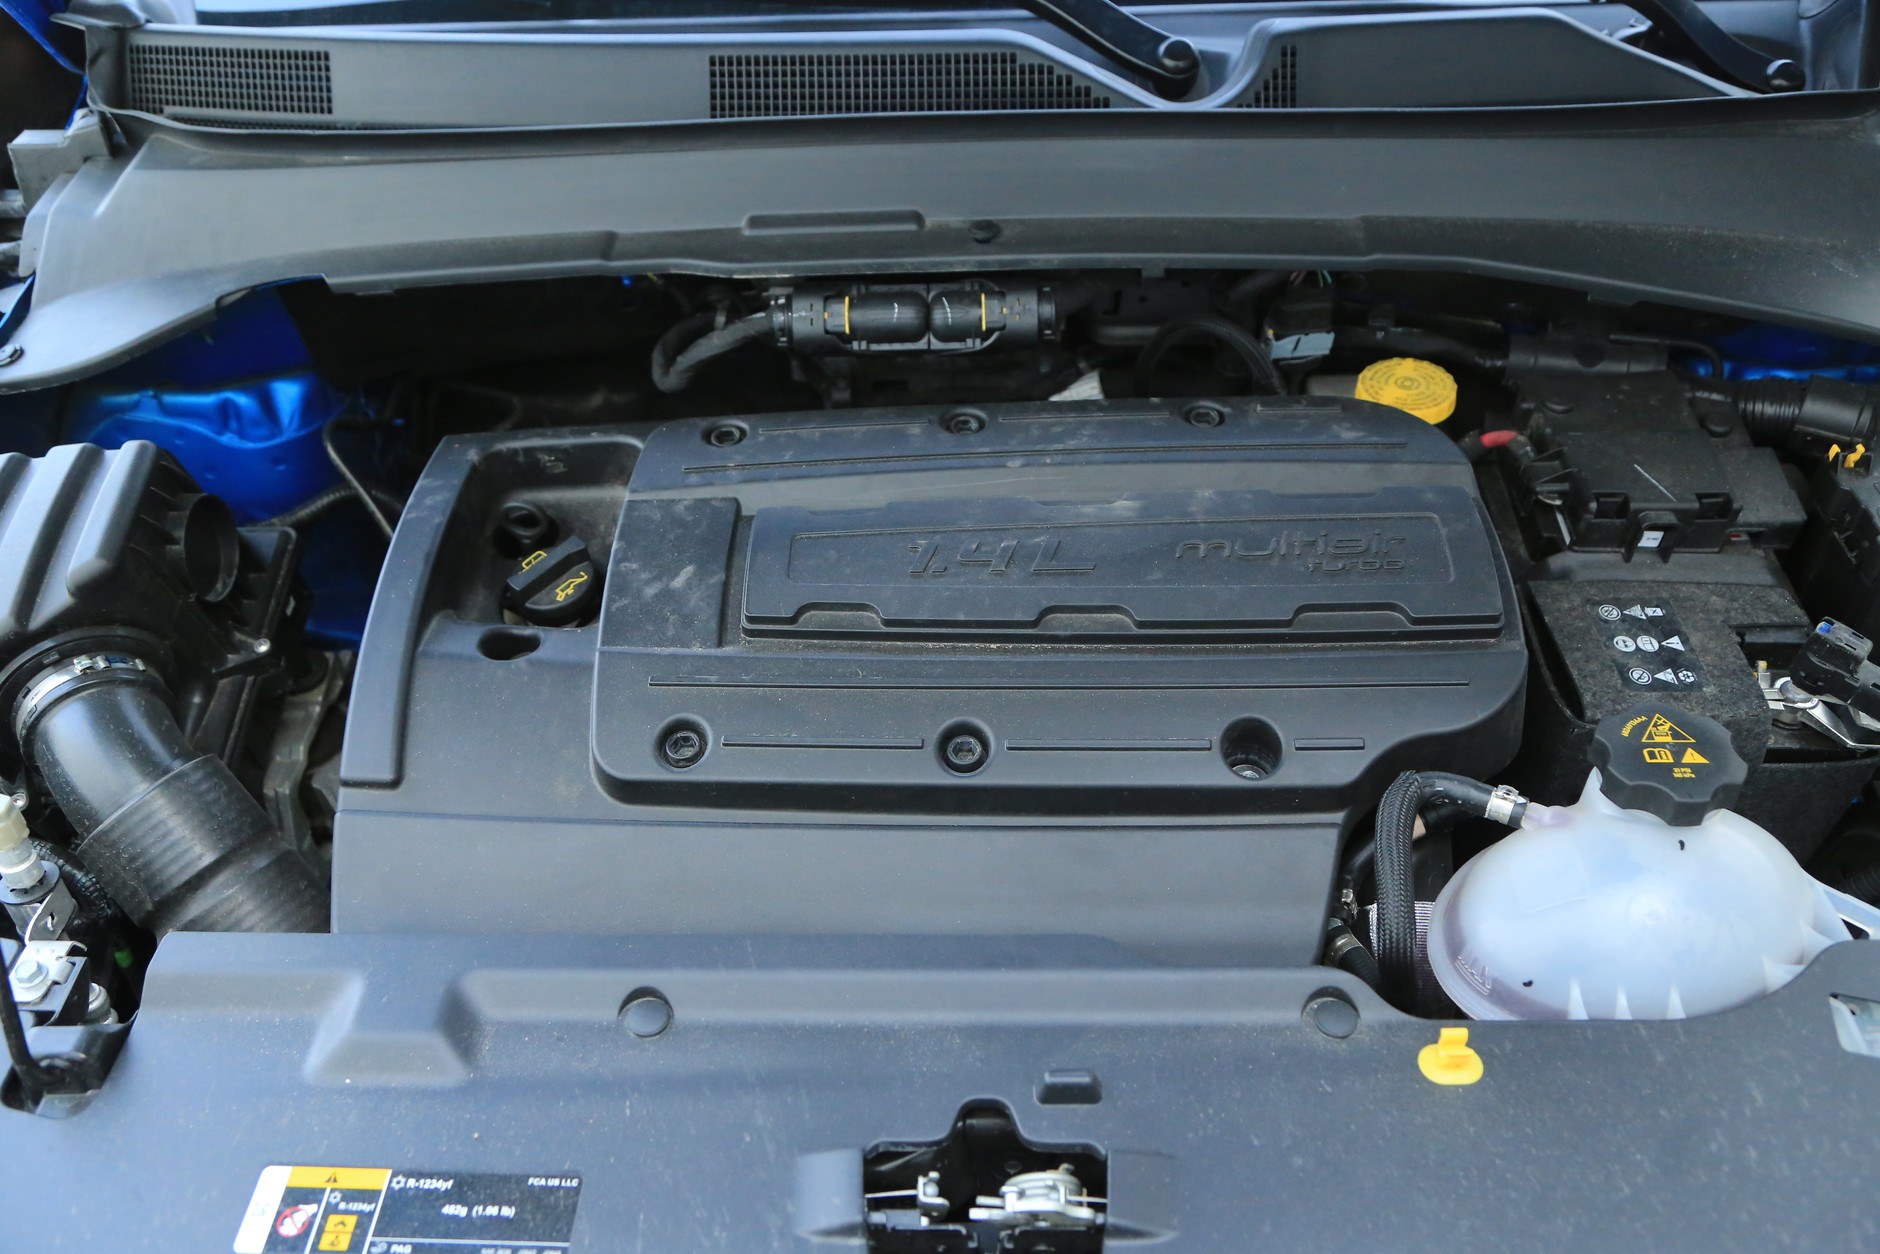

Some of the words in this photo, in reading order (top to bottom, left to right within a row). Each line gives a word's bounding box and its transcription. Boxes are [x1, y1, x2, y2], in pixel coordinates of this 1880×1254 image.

[406, 1177, 454, 1191] R-1234yf
[527, 1176, 546, 1186] FCA
[547, 1177, 560, 1187] US
[560, 1178, 579, 1188] LLC
